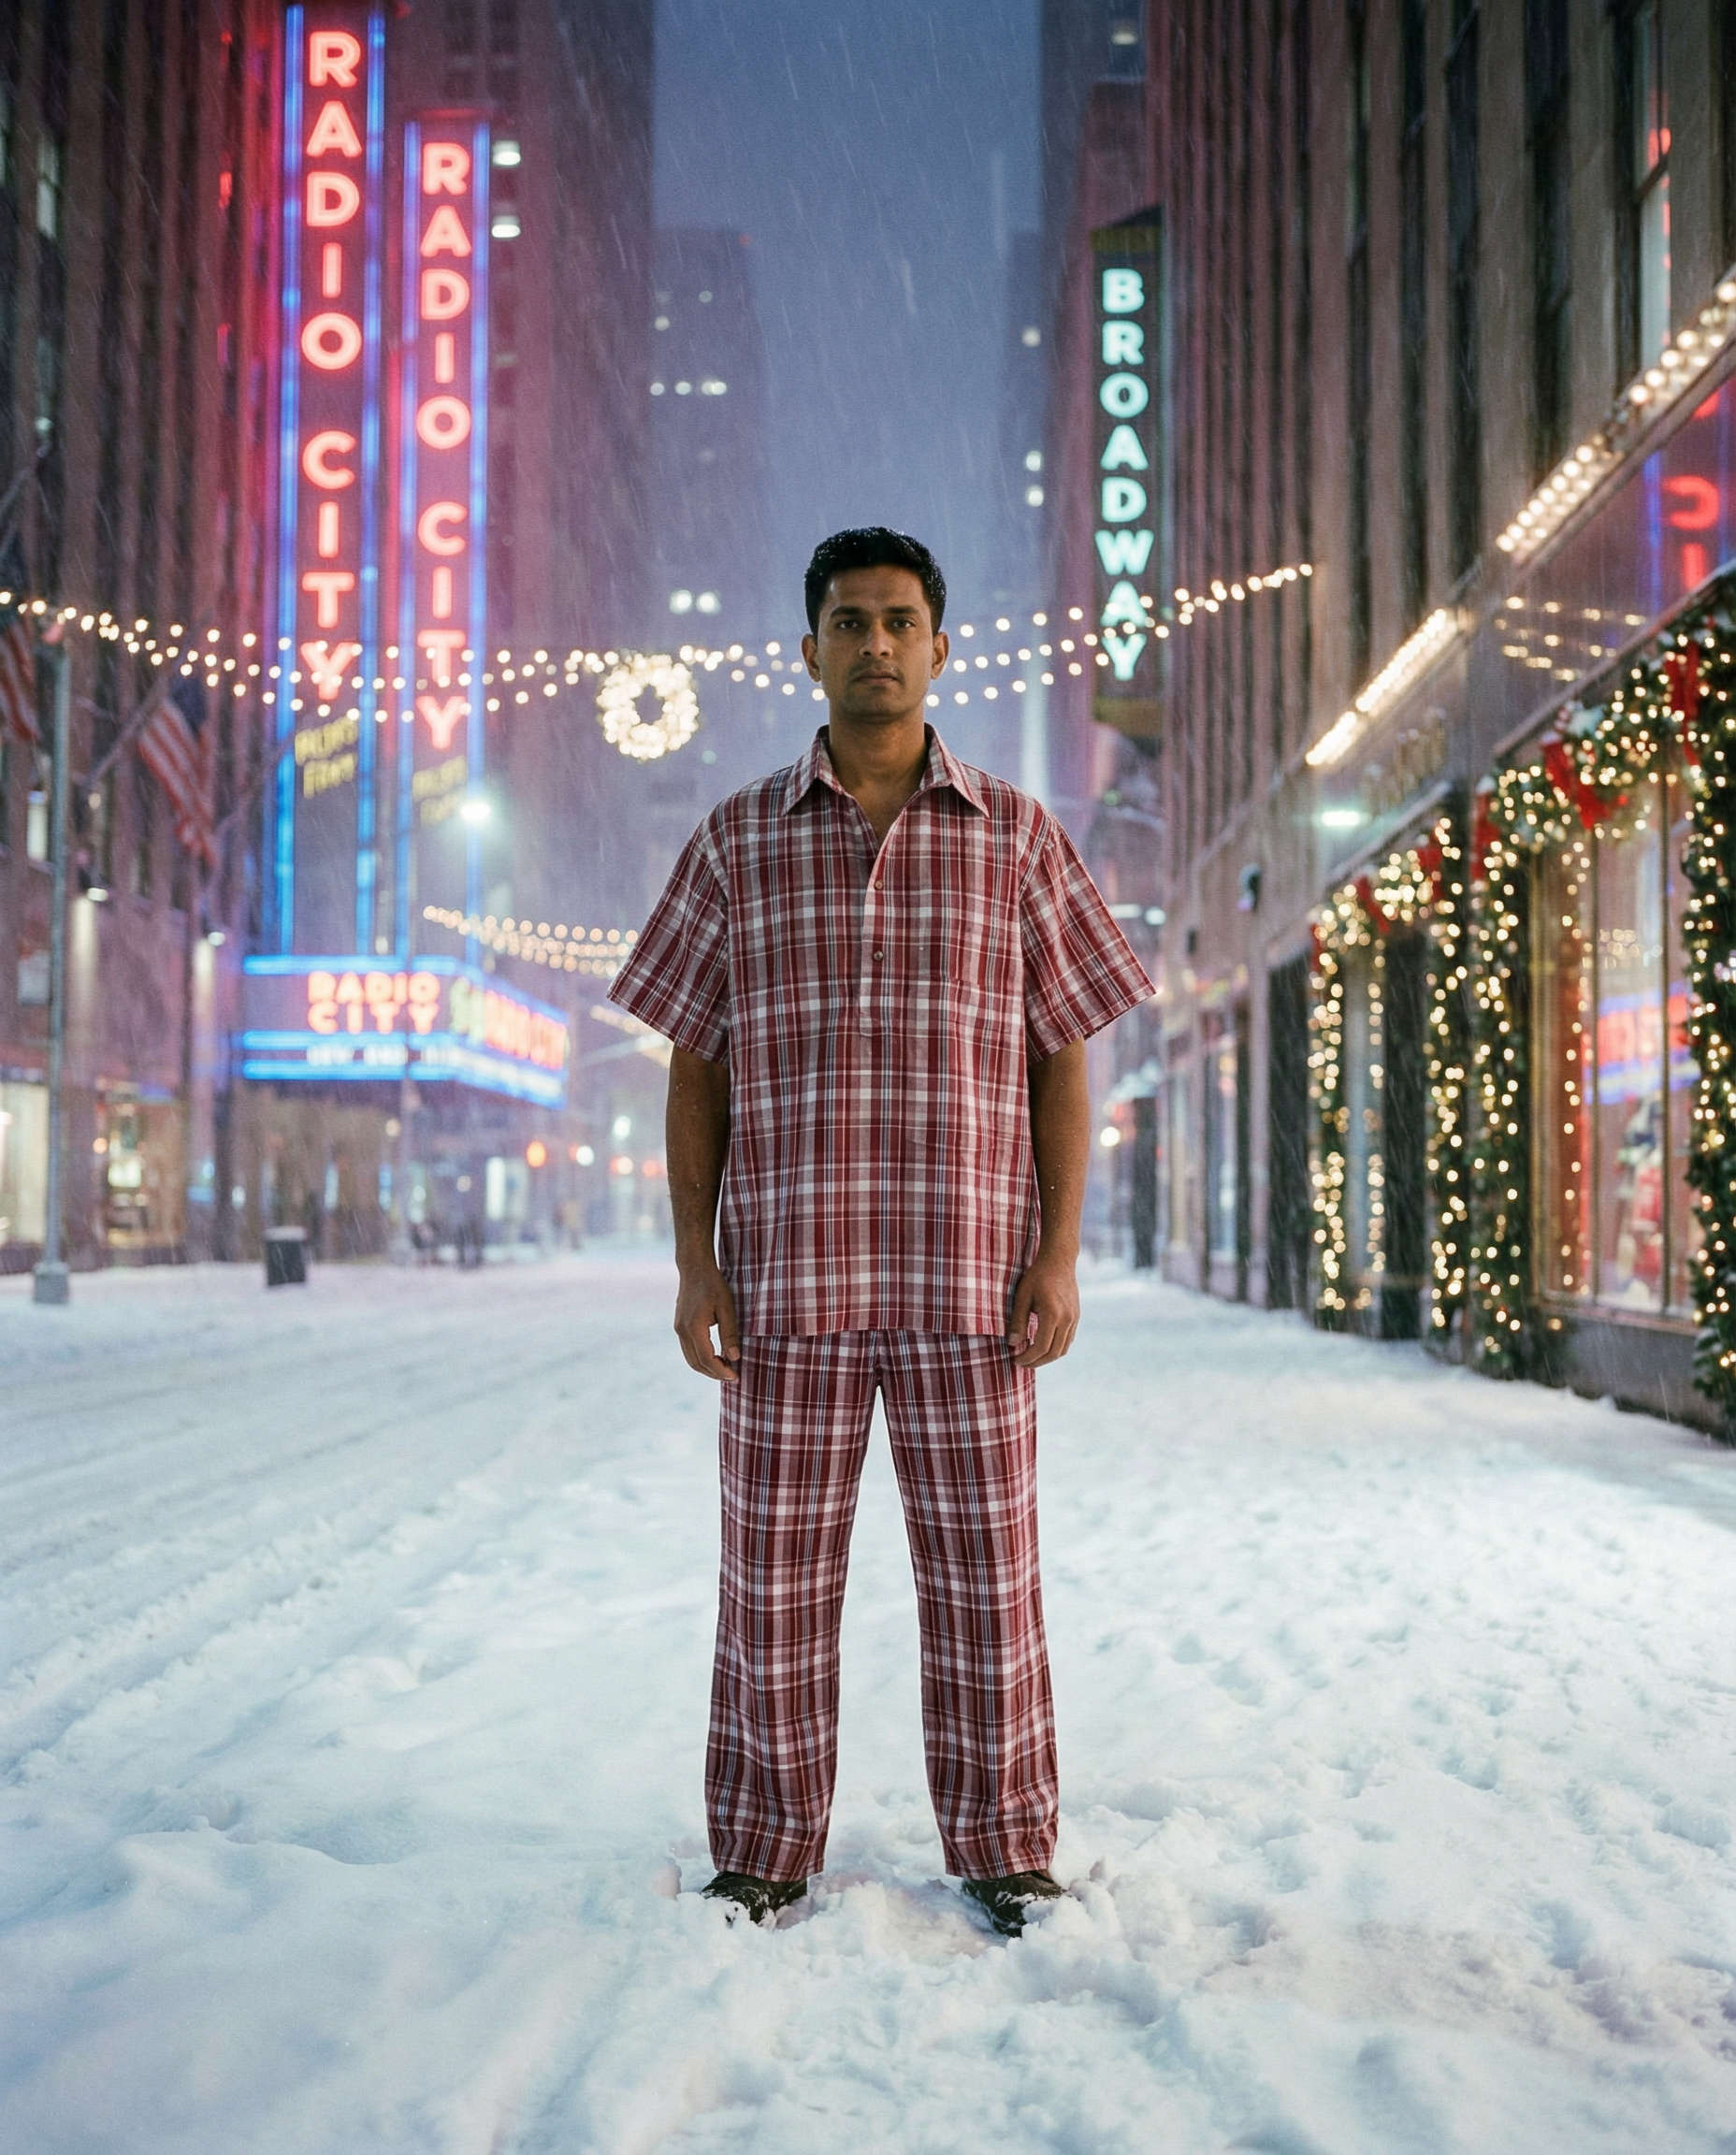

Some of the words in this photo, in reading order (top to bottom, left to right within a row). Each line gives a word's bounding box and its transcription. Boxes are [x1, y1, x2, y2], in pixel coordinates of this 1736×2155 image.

[302, 30, 363, 370] RADIO
[417, 142, 471, 449] RADIO
[300, 430, 357, 701] CITY
[1094, 268, 1154, 681] BROADWAY
[415, 501, 469, 750] CITY
[307, 970, 441, 1005] RADIO
[307, 1000, 441, 1035] CITY
